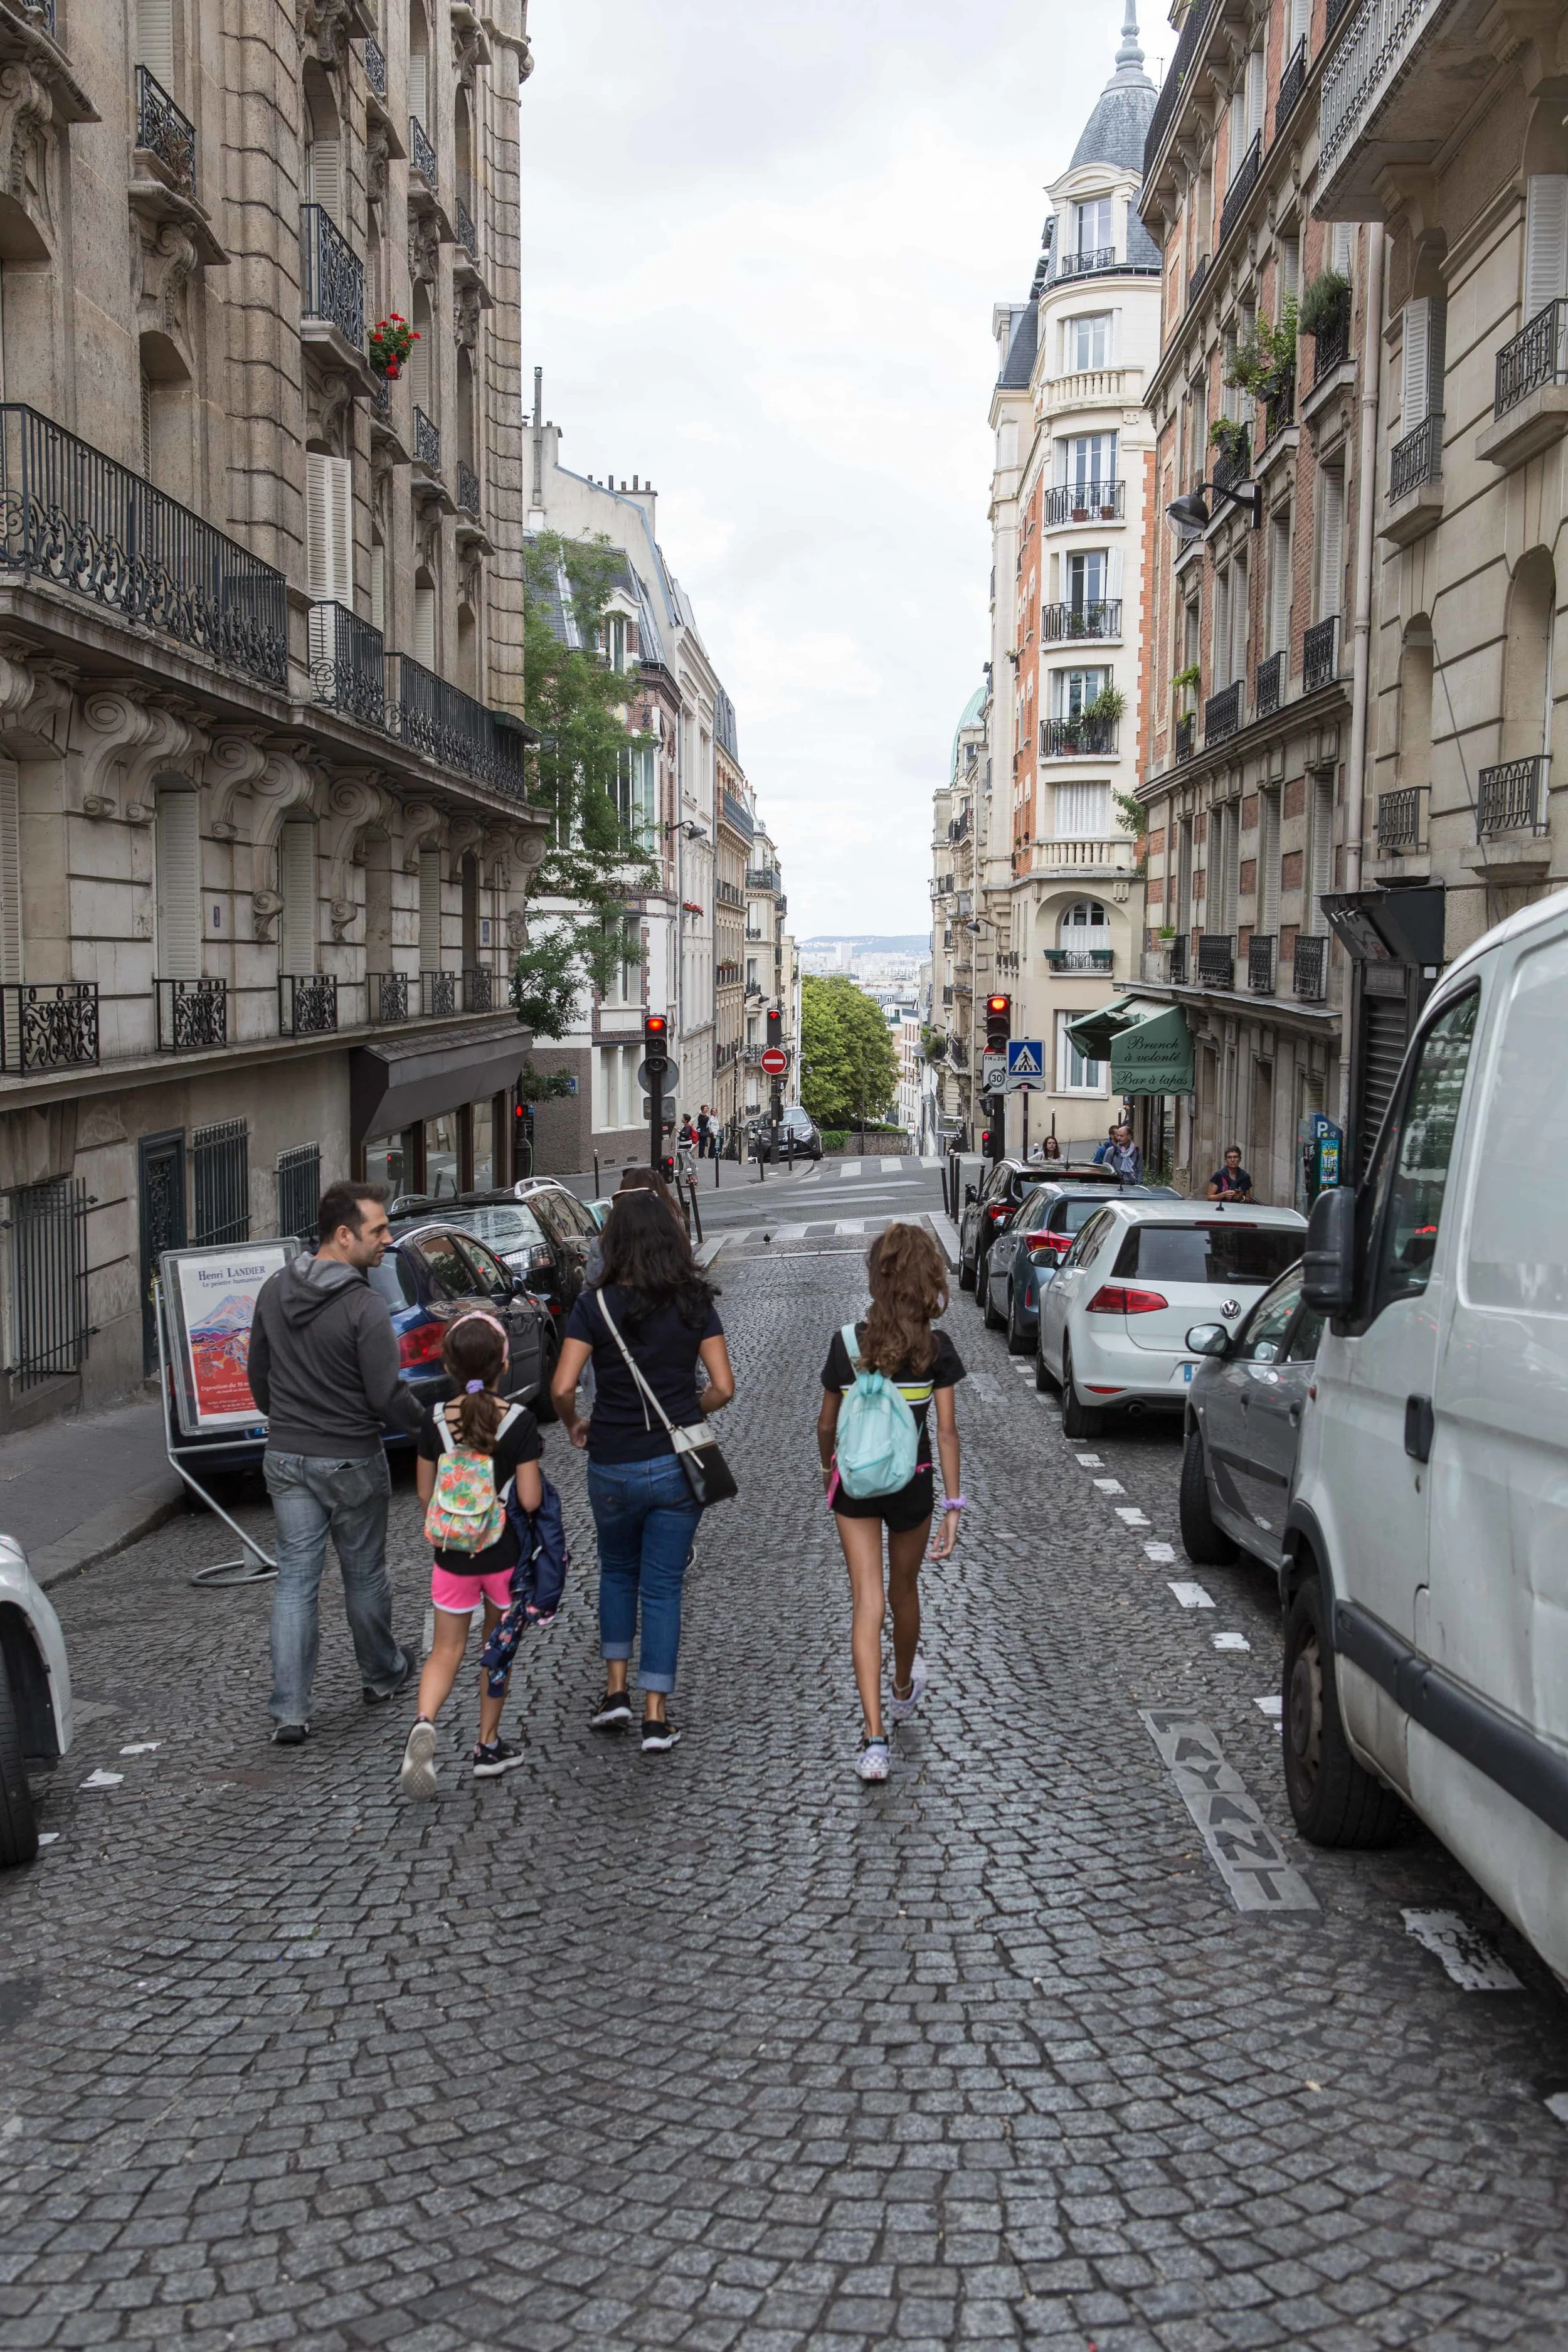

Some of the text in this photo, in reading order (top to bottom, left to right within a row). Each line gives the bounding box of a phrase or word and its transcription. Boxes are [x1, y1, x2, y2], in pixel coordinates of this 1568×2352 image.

[1127, 1036, 1180, 1049] Brunch
[1125, 1051, 1181, 1062] à volonté
[992, 1074, 1002, 1083] 30
[1116, 1071, 1188, 1087] Bar à tapas
[1317, 1121, 1328, 1138] P
[198, 1266, 266, 1281] Henri LANDIER
[211, 1279, 231, 1288] peintre
[201, 1383, 228, 1392] Exposition
